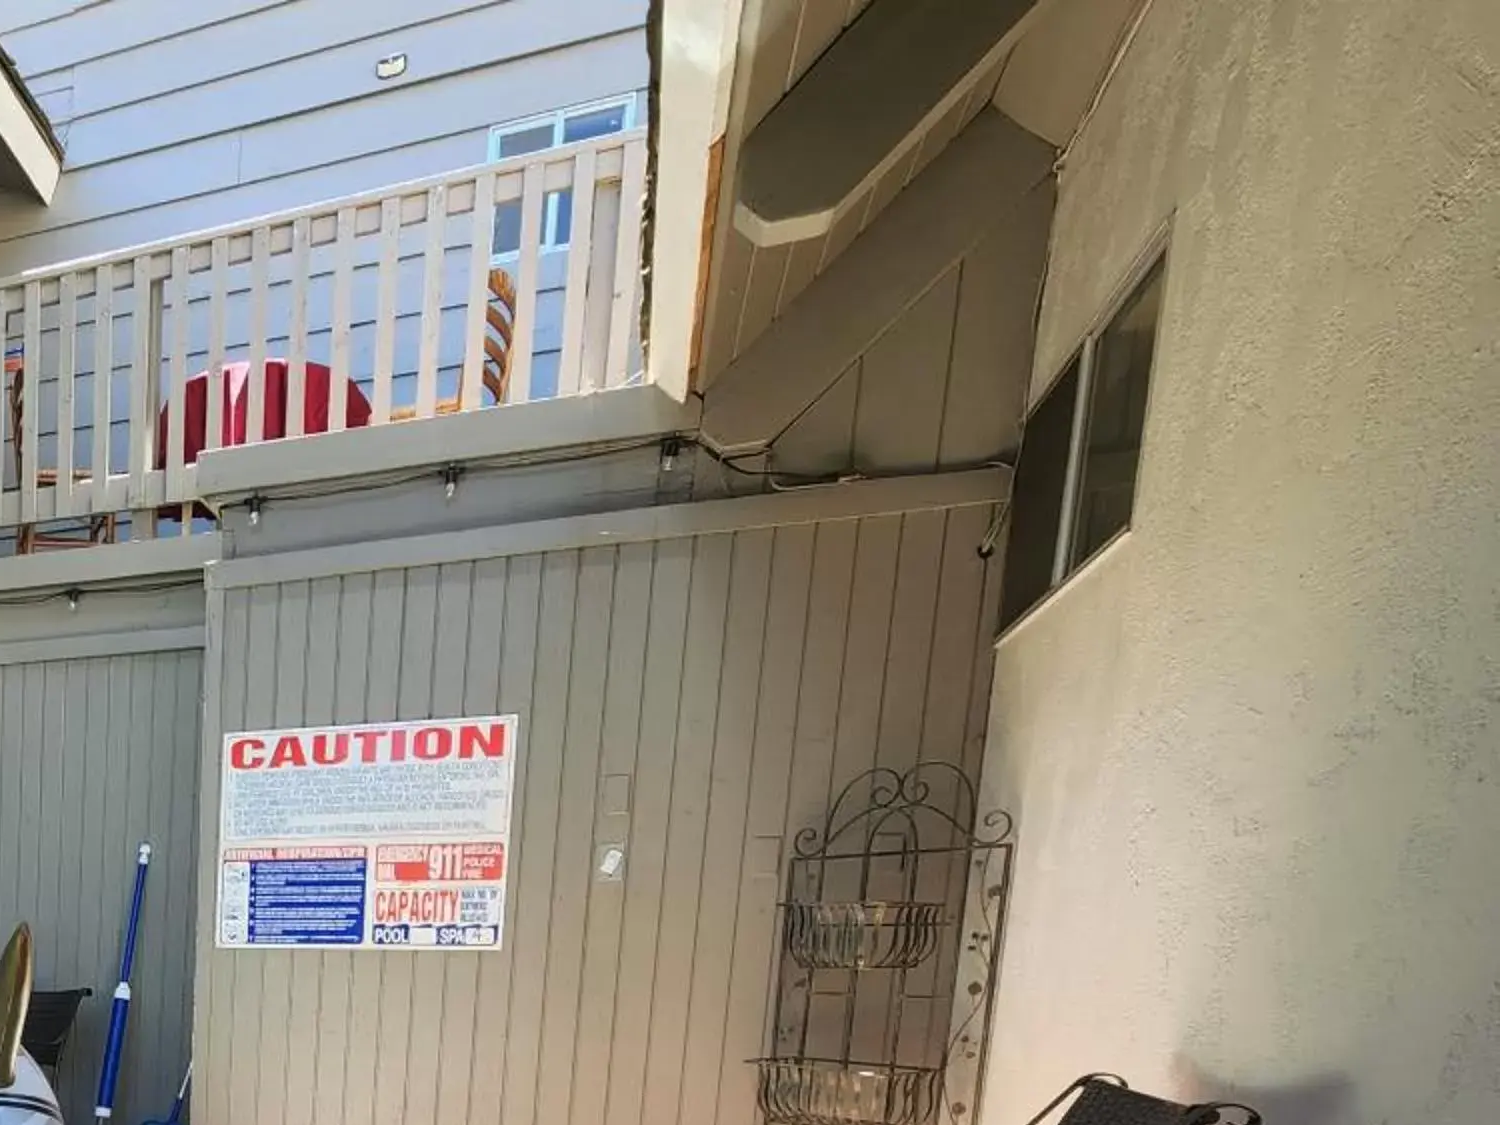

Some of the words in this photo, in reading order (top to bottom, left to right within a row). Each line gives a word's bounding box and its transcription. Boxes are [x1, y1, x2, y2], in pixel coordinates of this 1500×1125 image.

[231, 724, 505, 769] CAUTION
[429, 845, 462, 879] 911
[375, 891, 459, 923] CAPACITY
[375, 927, 409, 944] POOL
[439, 927, 465, 944] SPA
